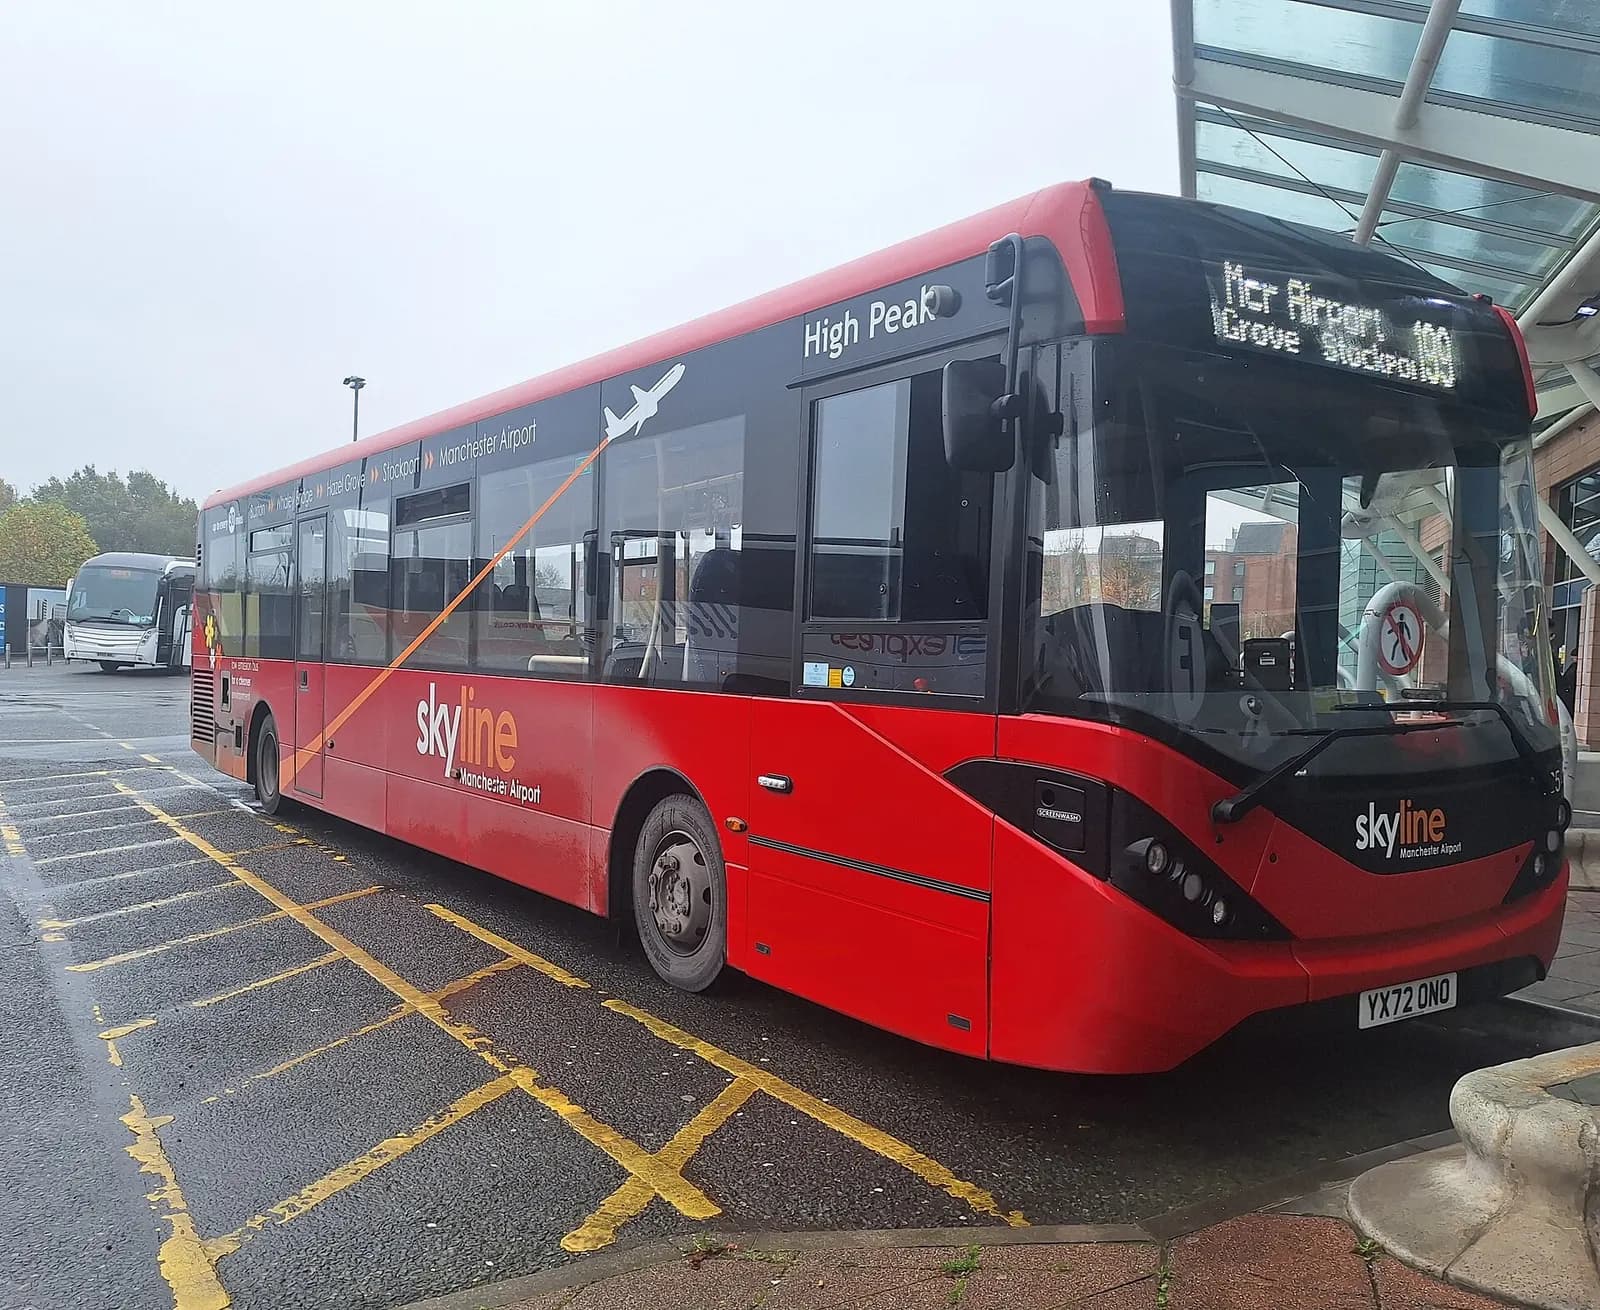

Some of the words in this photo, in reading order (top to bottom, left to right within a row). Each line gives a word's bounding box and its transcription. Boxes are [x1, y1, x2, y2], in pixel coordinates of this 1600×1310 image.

[1223, 261, 1278, 314] Mcr
[803, 310, 859, 359] High
[868, 285, 936, 338] Peak
[1221, 308, 1300, 353] Grove
[326, 478, 344, 497] Hazel
[344, 473, 366, 491] Grove
[382, 454, 420, 483] Stockport
[439, 433, 497, 467] Manchester
[499, 418, 537, 453] Airport
[416, 682, 518, 778] skyline
[459, 767, 508, 796] Manchester
[509, 779, 541, 804] Airport
[1038, 808, 1080, 822] SCREENWASH
[1355, 799, 1447, 859] skyline
[1400, 843, 1440, 859] Manchester
[1440, 842, 1462, 855] Airport
[1367, 985, 1413, 1021] YX72
[1417, 978, 1451, 1010] ONO
